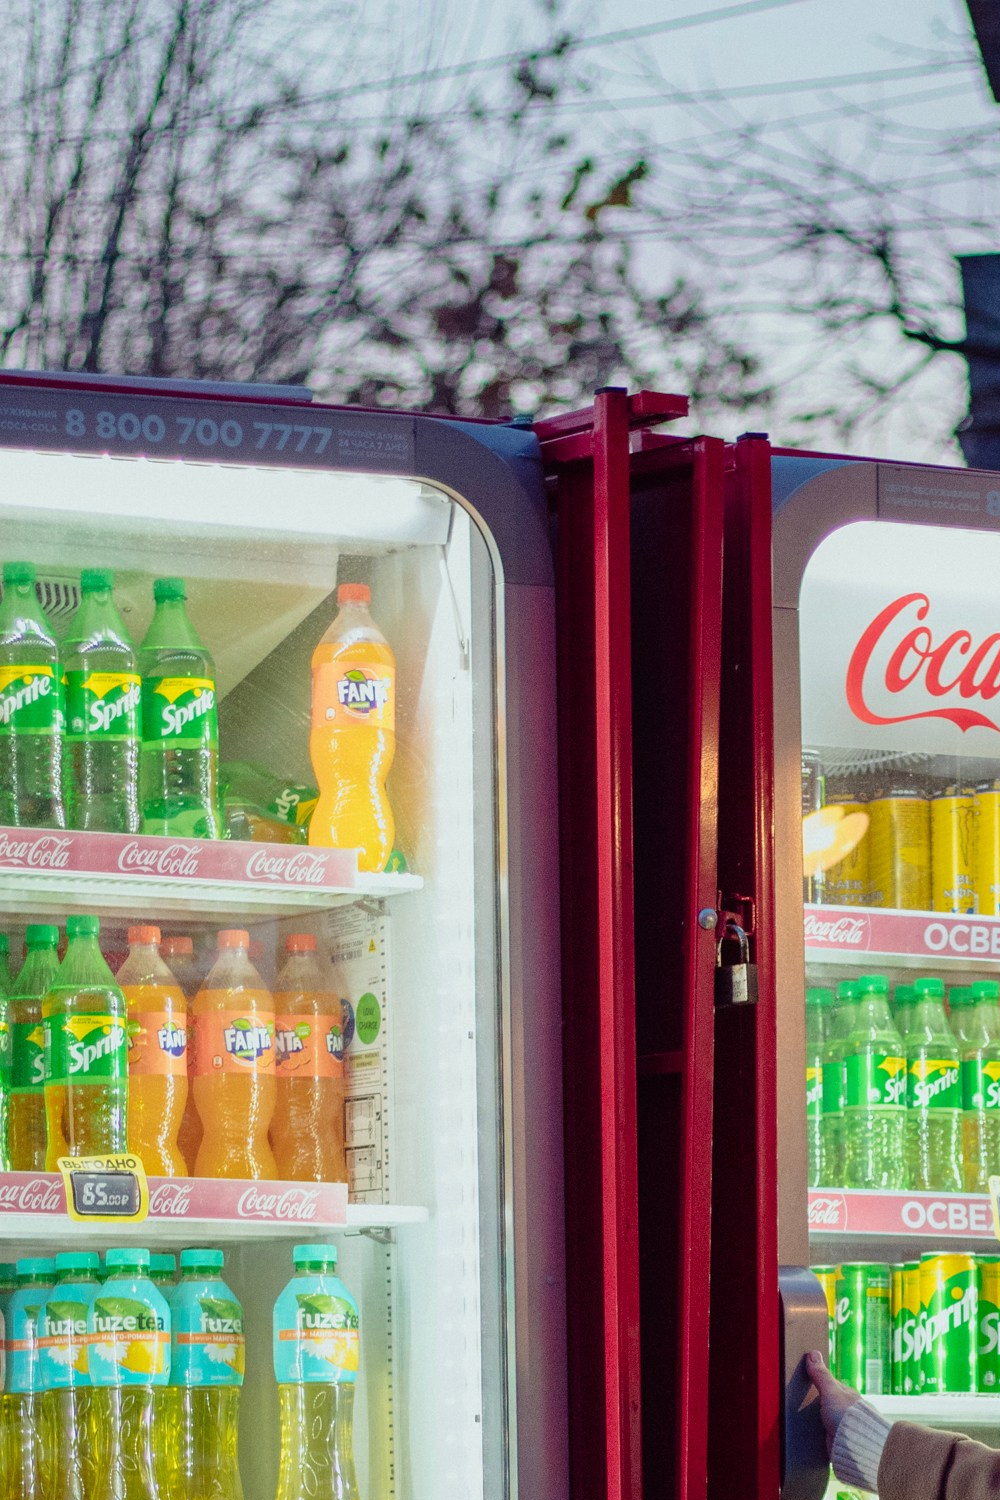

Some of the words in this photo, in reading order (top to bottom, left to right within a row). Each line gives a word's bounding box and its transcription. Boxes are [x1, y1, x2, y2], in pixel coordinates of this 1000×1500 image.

[65, 409, 86, 437] 8
[96, 411, 166, 443] 800
[175, 416, 243, 448] 700
[253, 421, 333, 454] 7777
[89, 681, 142, 732] Sprite
[161, 689, 215, 737] Sprite
[118, 841, 203, 876] Coca-Cola
[245, 848, 330, 883] Coca-Cola
[69, 1025, 126, 1074] Sprite
[913, 1068, 960, 1107] Sprite
[62, 1158, 137, 1171] ВЫГОДНО
[237, 1186, 321, 1219] Coca-Cola
